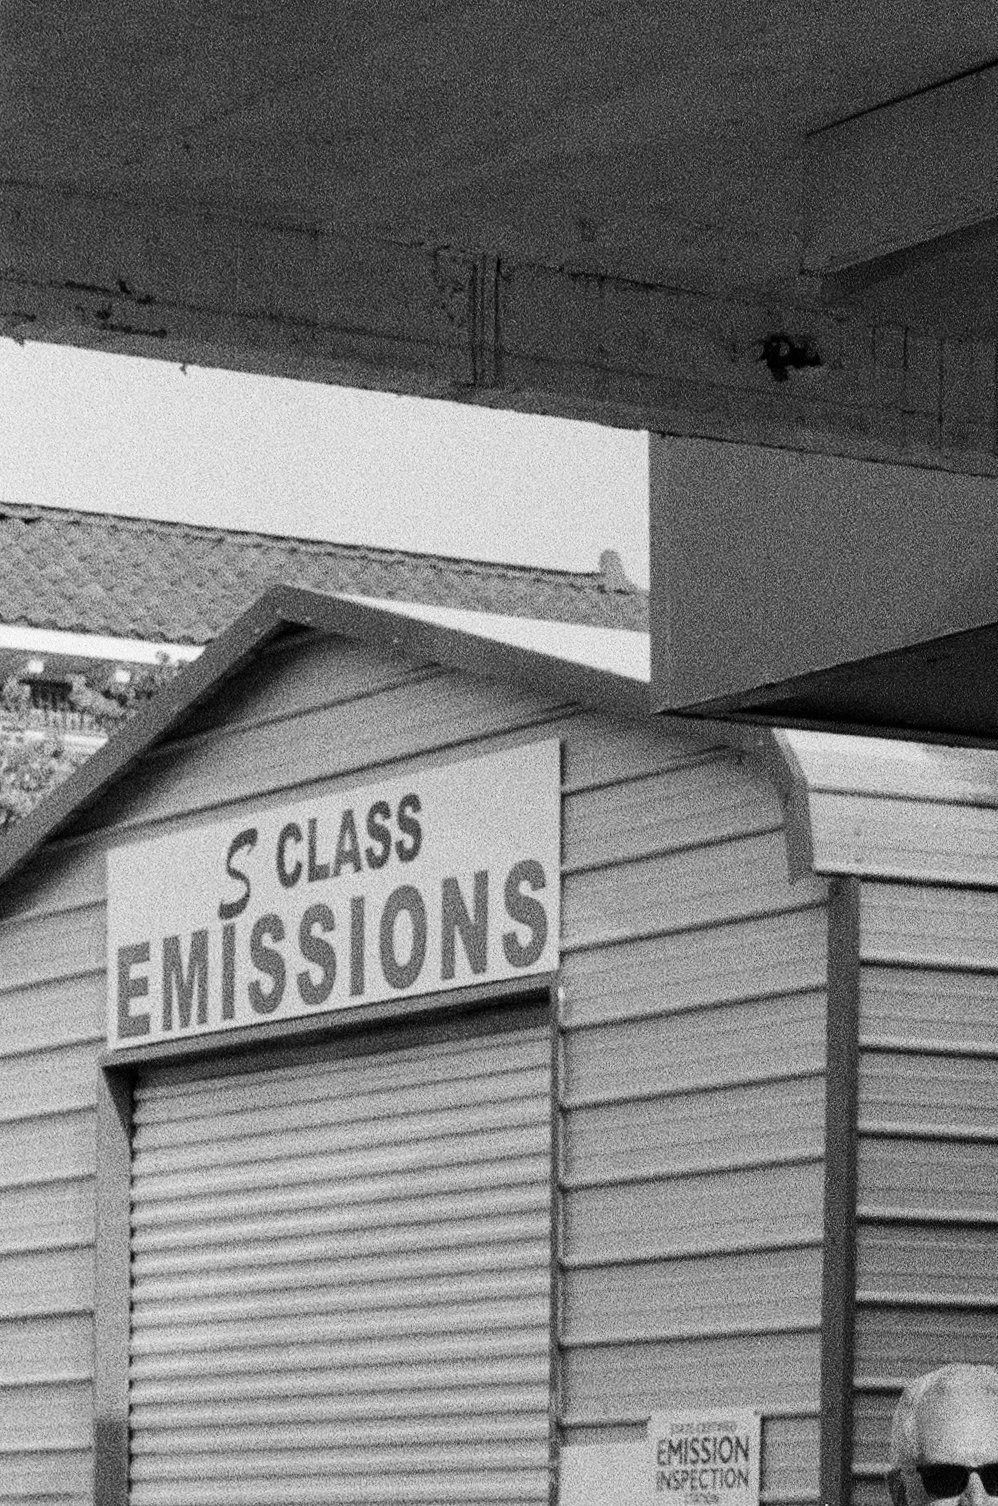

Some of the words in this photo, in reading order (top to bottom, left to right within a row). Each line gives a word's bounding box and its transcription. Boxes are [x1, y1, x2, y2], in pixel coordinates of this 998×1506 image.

[217, 827, 259, 920] S
[276, 792, 423, 889] CLASS
[116, 858, 550, 1040] EMISSIONS
[656, 1435, 750, 1466] EMISSION
[656, 1467, 750, 1492] INSPECTION
